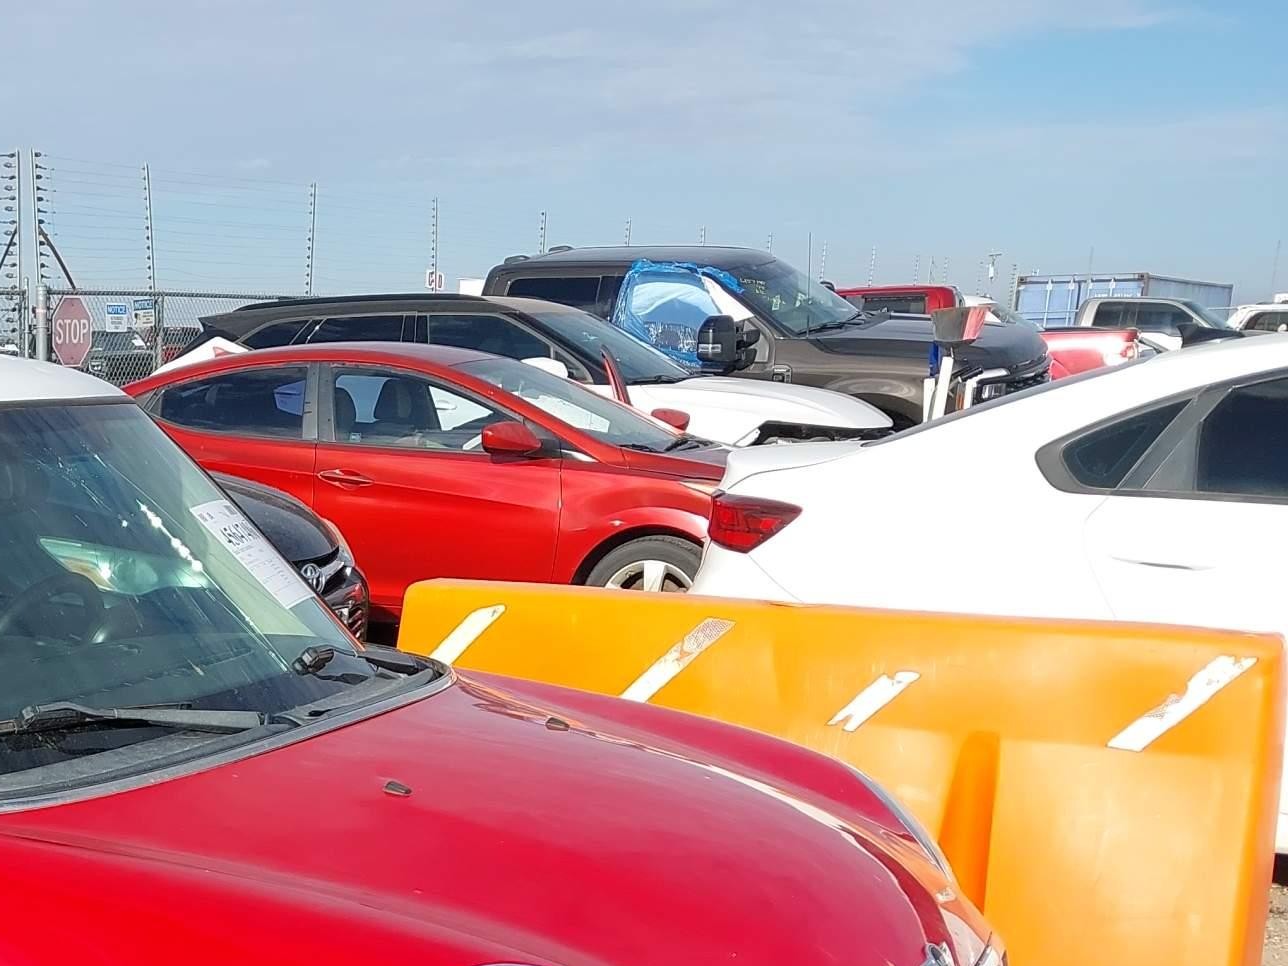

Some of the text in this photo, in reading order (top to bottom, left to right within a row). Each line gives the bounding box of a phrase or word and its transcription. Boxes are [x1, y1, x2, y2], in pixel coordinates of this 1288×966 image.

[108, 305, 126, 314] NOTICE
[134, 299, 153, 310] NOTICE
[55, 319, 89, 344] STOP
